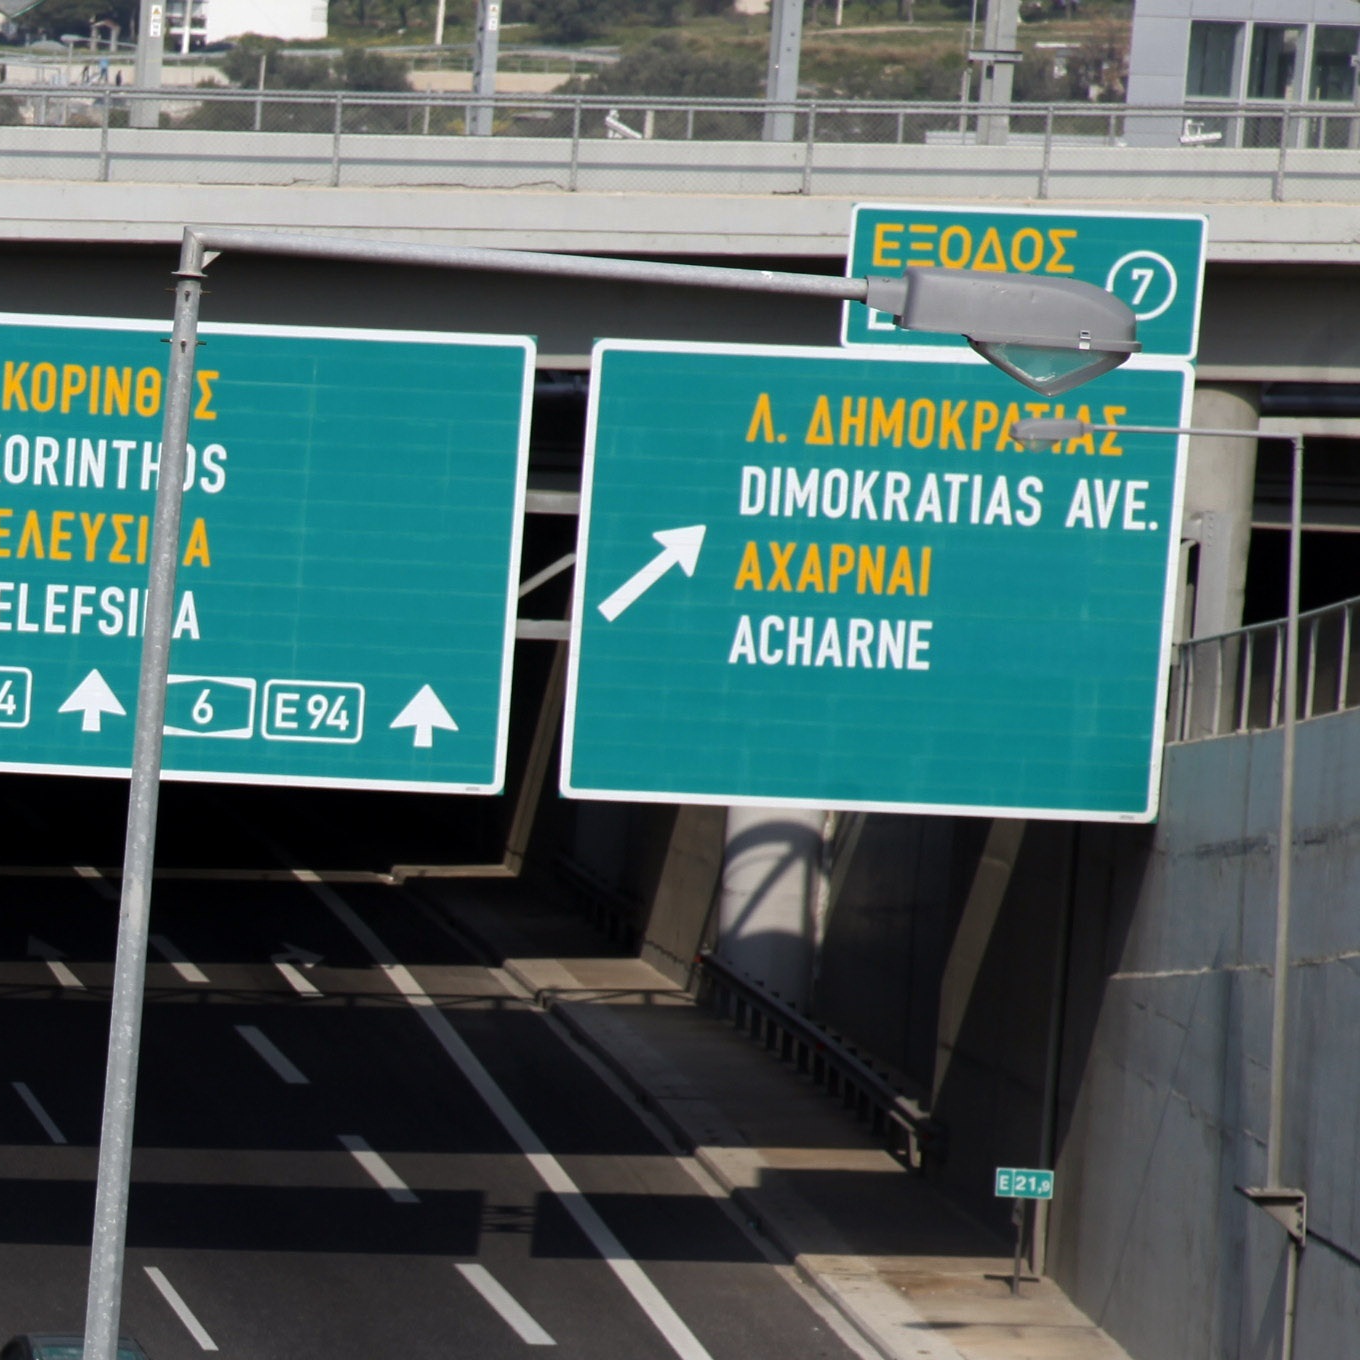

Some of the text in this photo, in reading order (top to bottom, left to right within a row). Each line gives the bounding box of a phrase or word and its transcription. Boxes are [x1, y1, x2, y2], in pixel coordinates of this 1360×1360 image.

[872, 223, 1077, 273] ΕΞΟΔΟΣ
[1131, 268, 1155, 306] 7
[2, 361, 220, 420] ΚΟΡΙΝΘΣ
[739, 465, 1159, 532] DIMOKRATIAS AVE.
[735, 541, 932, 596] ΑΧΑΡΝΑΙ
[728, 614, 933, 671] ACHARNE
[191, 688, 214, 724] 6
